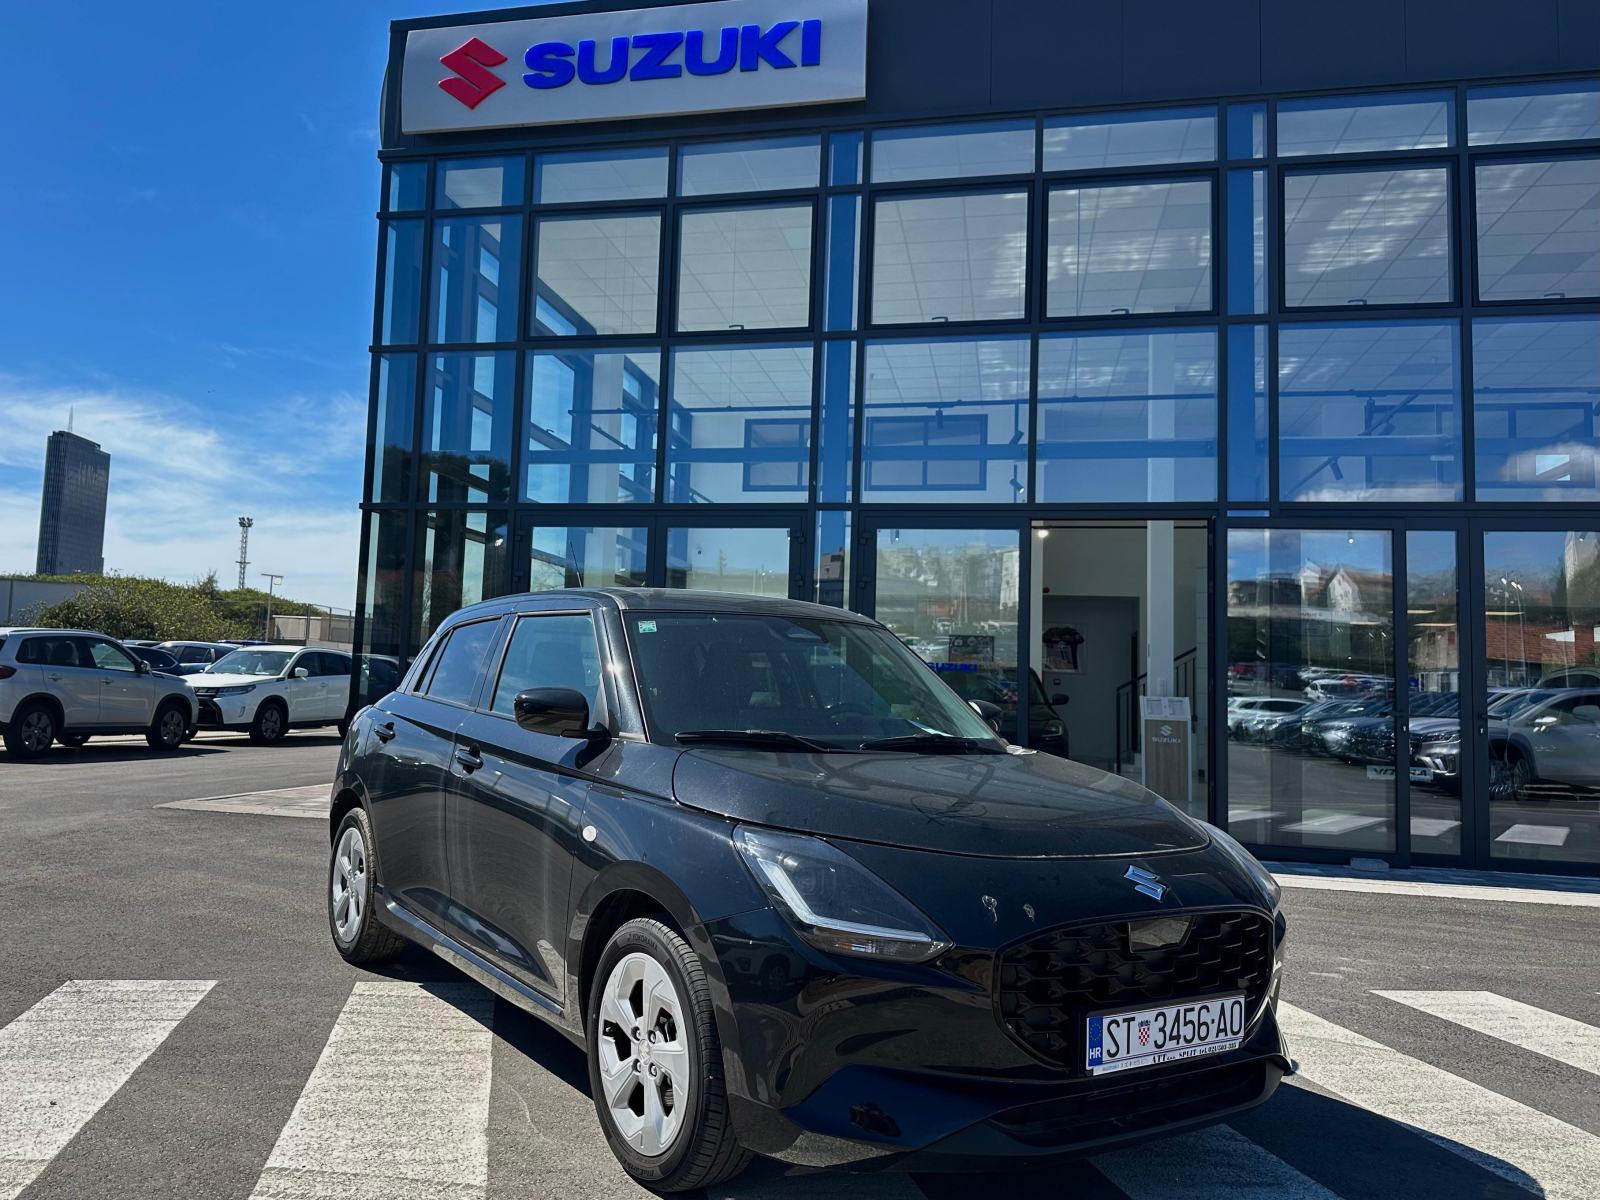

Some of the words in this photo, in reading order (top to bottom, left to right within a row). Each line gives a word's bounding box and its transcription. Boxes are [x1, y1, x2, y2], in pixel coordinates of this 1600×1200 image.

[522, 19, 821, 90] SUZUKI
[1151, 736, 1182, 744] SUZUKI
[1106, 1016, 1136, 1058] ST
[1089, 1047, 1102, 1060] HR
[1179, 1049, 1197, 1059] SPLIT
